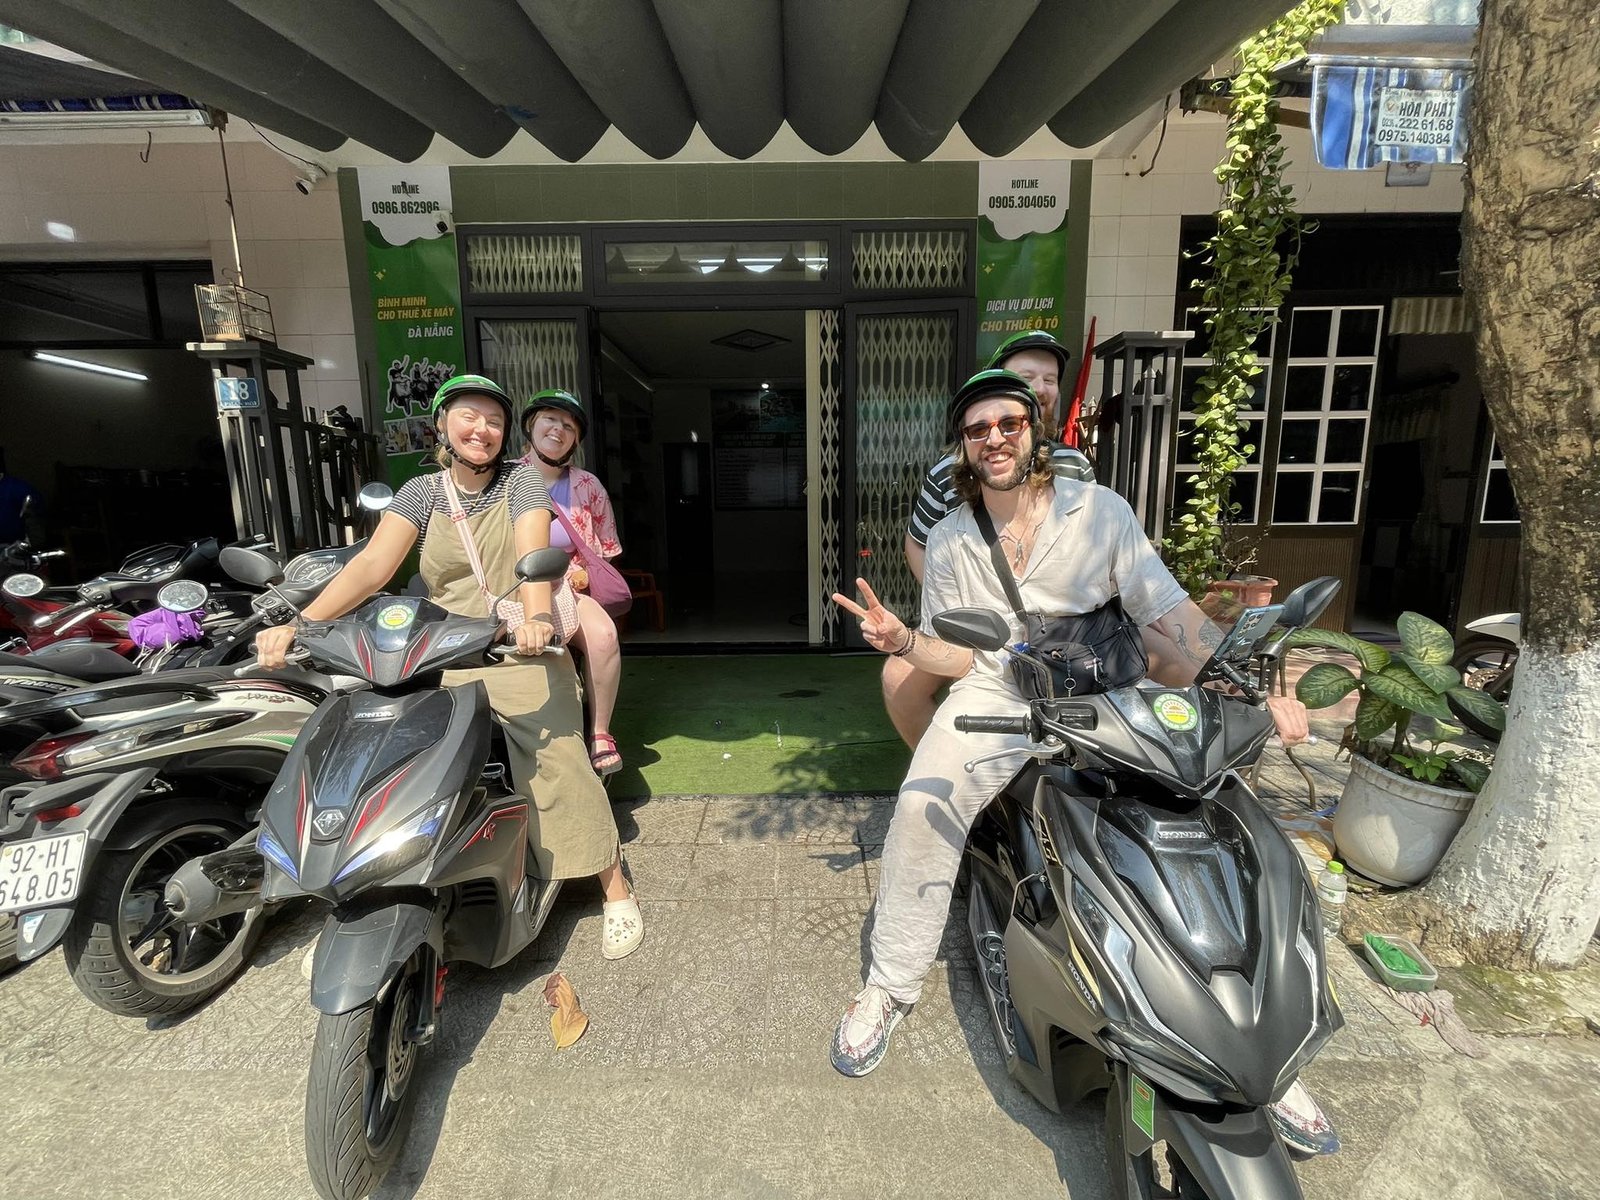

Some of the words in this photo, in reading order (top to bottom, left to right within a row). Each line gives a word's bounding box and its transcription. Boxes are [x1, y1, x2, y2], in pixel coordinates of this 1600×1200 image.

[1378, 129, 1451, 144] 0975.140384
[1011, 179, 1039, 189] HOTLINE
[372, 201, 440, 214] 0986.862986
[989, 195, 1056, 209] 0905.304050
[377, 296, 400, 308] BÌNH
[401, 296, 427, 307] MINH
[986, 299, 1006, 314] DỊCH
[1008, 298, 1020, 313] VỤ
[1021, 298, 1034, 310] DU
[1034, 297, 1054, 311] LỊCH
[377, 310, 396, 320] CHO
[397, 307, 420, 319] THUÊ
[421, 308, 433, 318] XE
[433, 306, 455, 317] MÁY
[408, 325, 422, 338] ĐÀ
[424, 322, 454, 338] NẴNG
[981, 320, 1002, 332] CHO
[1005, 316, 1034, 331] THUÊ
[1034, 315, 1042, 329] Ô
[1045, 315, 1059, 329] TÔ
[228, 381, 250, 400] 18
[1158, 831, 1210, 839] HONDA
[10, 838, 70, 874] 92-H1
